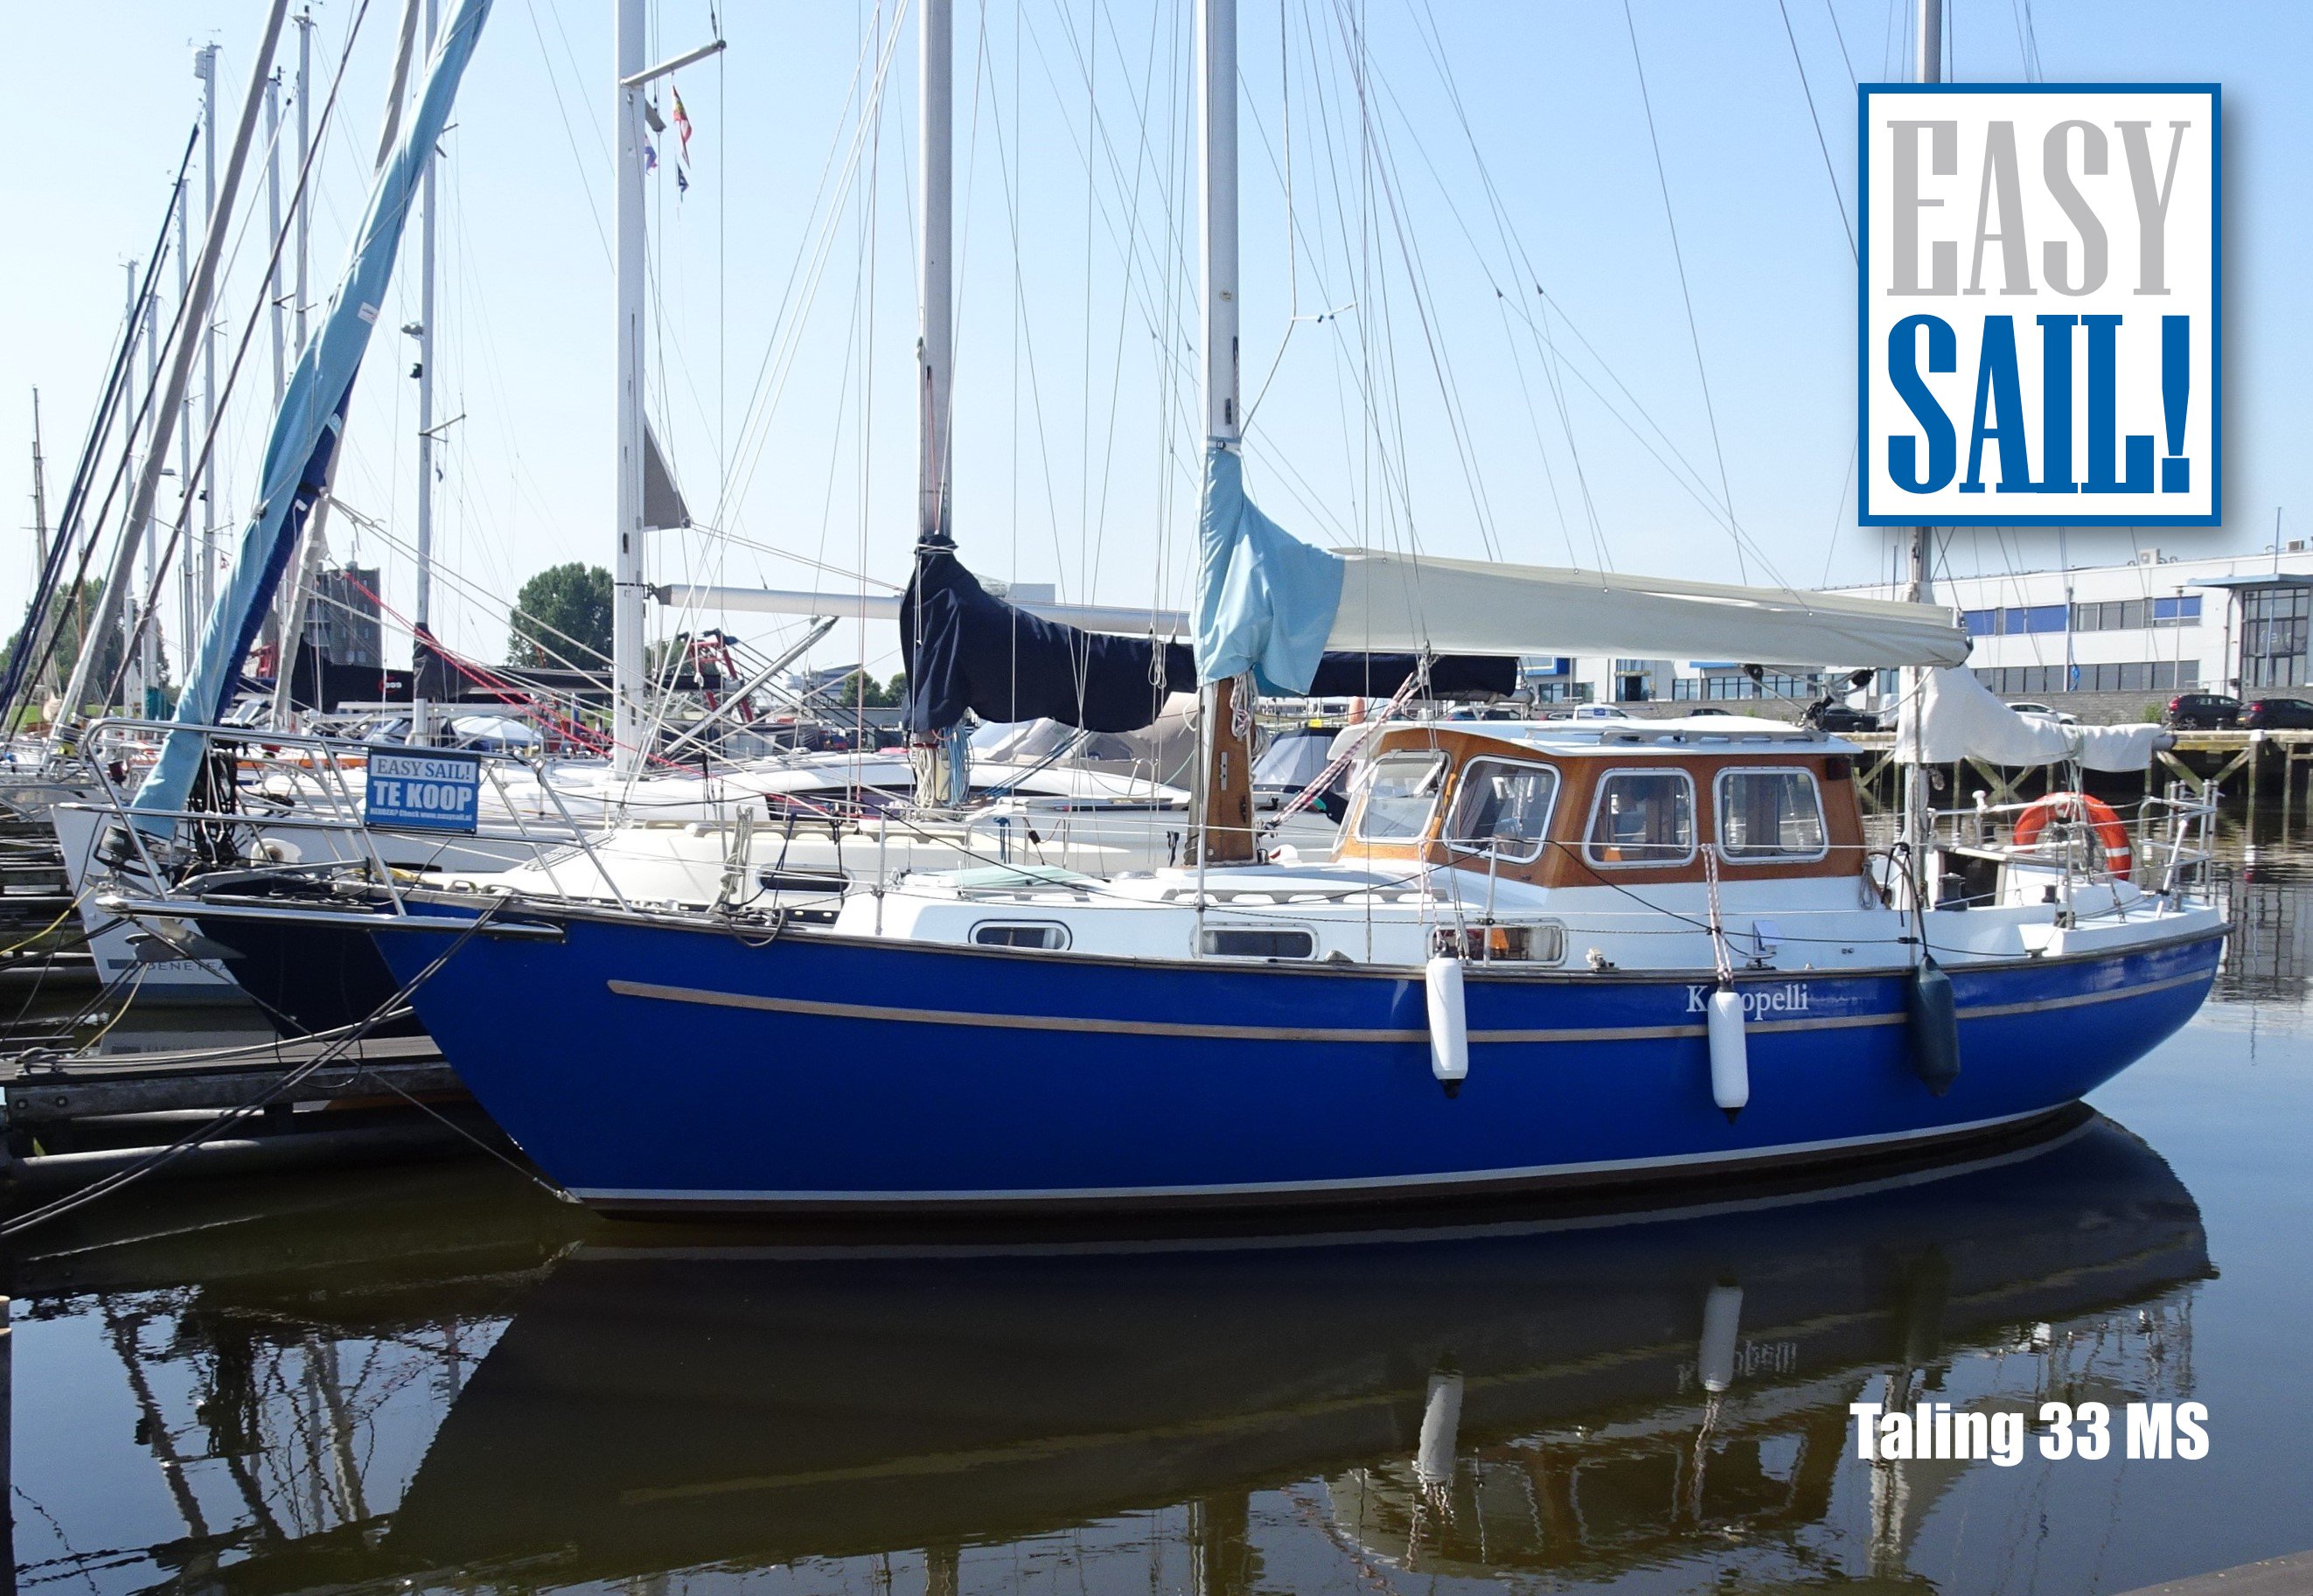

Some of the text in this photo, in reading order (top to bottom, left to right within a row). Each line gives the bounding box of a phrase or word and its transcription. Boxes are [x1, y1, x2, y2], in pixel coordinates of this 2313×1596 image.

[377, 758, 470, 780] EASY SAIL!
[373, 780, 473, 812] TE KOOP
[1686, 983, 1809, 1021] Kopelli
